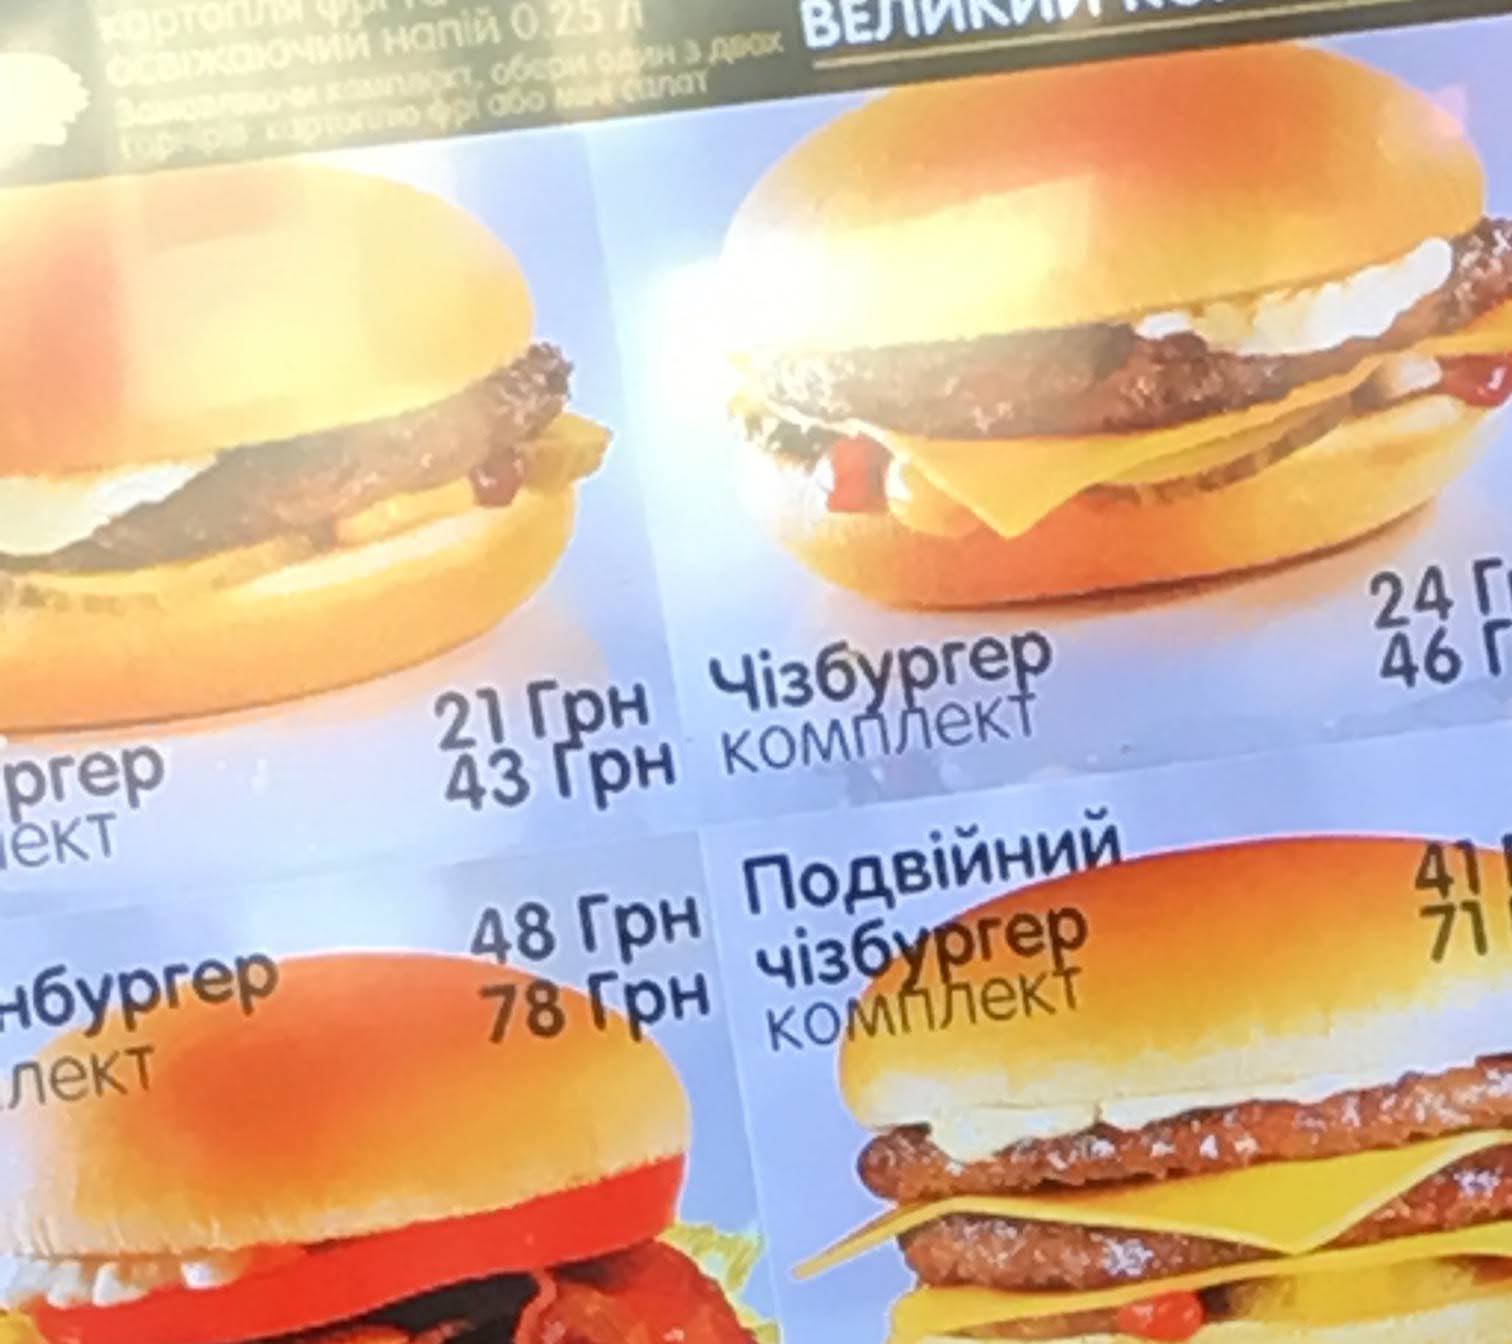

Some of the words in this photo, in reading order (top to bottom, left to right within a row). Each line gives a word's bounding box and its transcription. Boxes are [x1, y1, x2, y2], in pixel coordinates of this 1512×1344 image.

[383, 9, 501, 56] напій
[489, 86, 547, 117] або
[708, 628, 1053, 716] Чізбургер
[1369, 570, 1454, 632] 24
[719, 694, 1039, 777] комплект
[1378, 627, 1462, 690] 46
[432, 687, 506, 752] 21
[526, 679, 652, 745] Грн
[0, 811, 117, 871] ект
[443, 746, 531, 810] 43
[551, 740, 678, 810] Грн
[740, 808, 1124, 917] Подвійний
[470, 902, 557, 965] 48
[577, 892, 702, 964] Грн
[754, 900, 1090, 992] чізбургер
[1413, 843, 1485, 903] 41
[765, 965, 1084, 1053] комплект
[1417, 902, 1487, 964] 71
[0, 1045, 155, 1110] лект
[479, 979, 567, 1045] 78
[587, 969, 711, 1042] Грн
